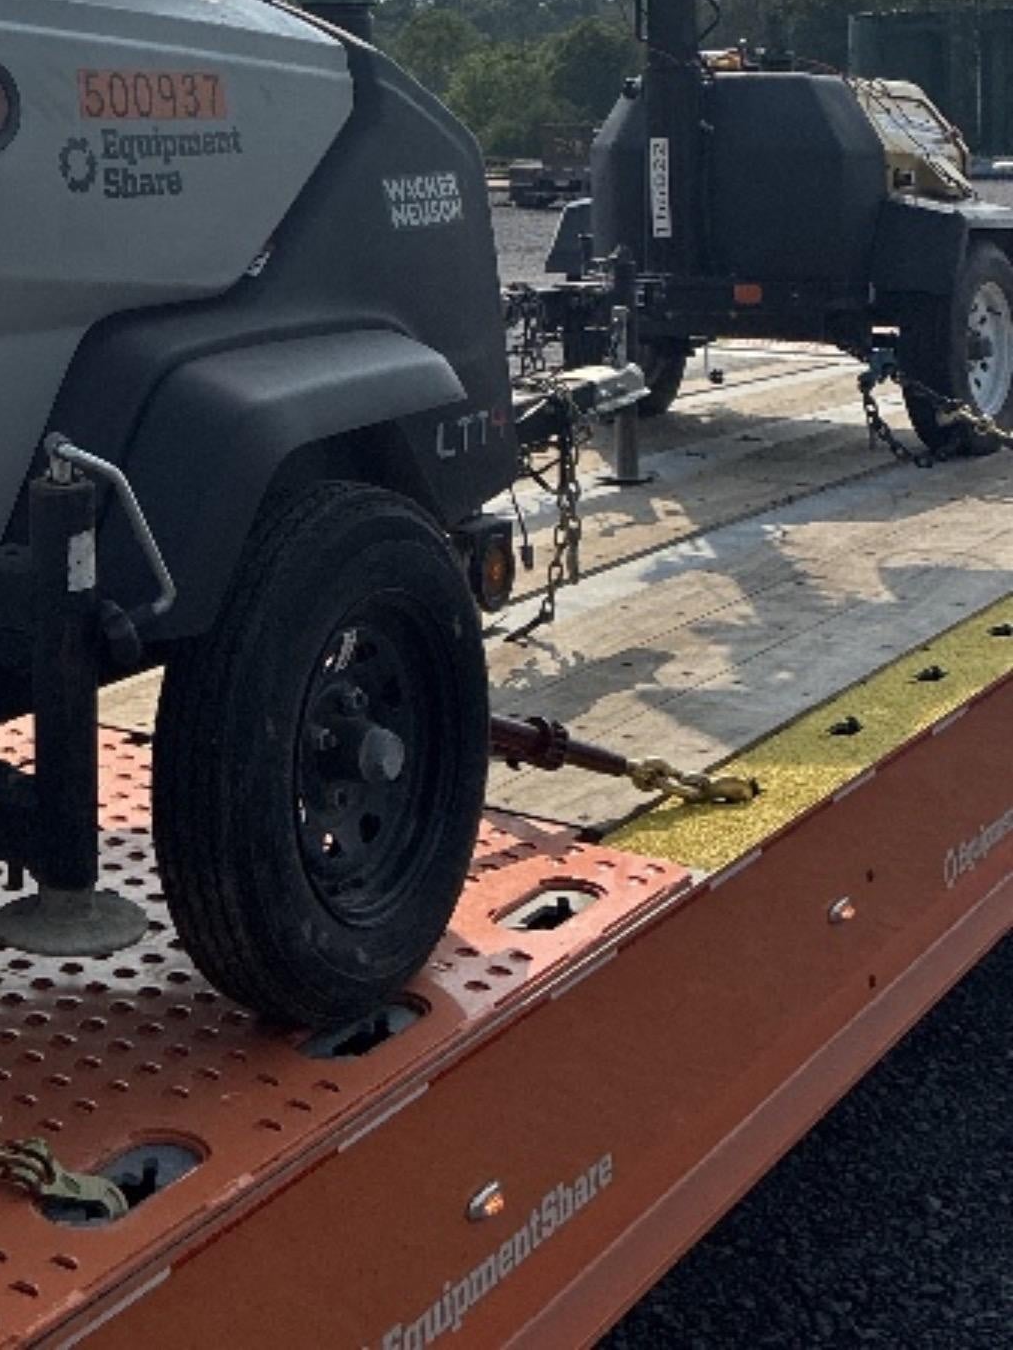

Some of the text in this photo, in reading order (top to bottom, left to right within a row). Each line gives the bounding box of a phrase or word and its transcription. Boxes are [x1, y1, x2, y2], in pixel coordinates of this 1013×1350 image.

[84, 72, 221, 119] 500937
[100, 125, 243, 165] Equipment
[103, 167, 183, 199] Share
